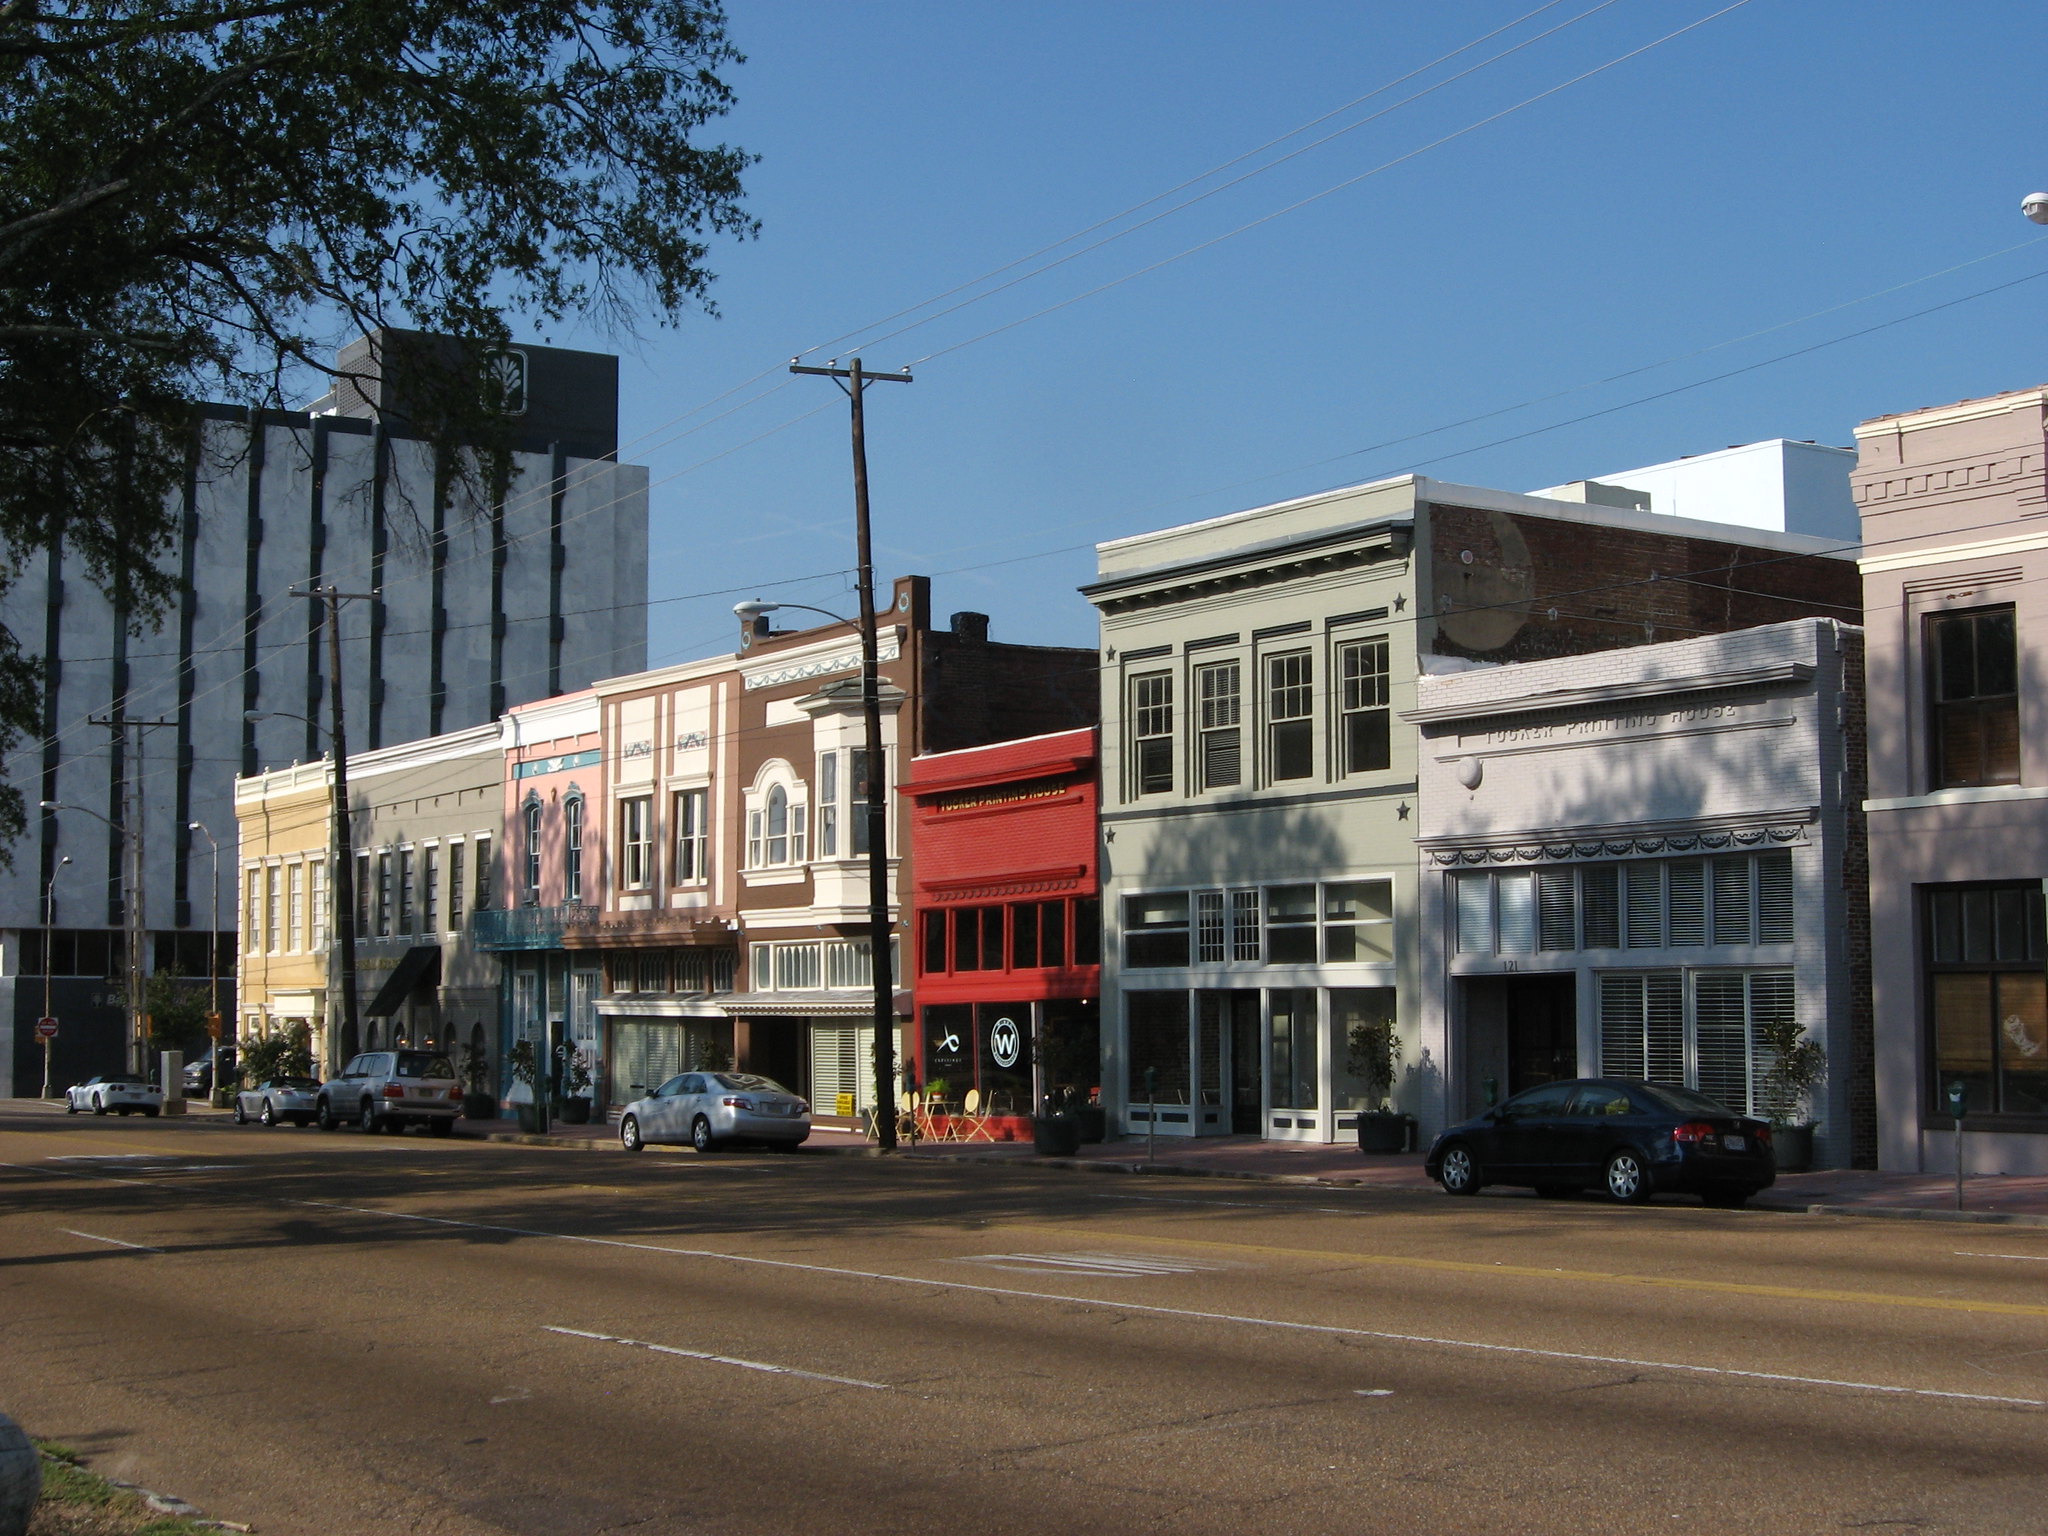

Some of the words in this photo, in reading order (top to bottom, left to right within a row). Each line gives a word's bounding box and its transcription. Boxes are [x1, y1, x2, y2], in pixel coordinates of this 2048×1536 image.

[1484, 724, 1553, 744] TUCKER
[1565, 711, 1656, 734] PRINTING
[1670, 704, 1735, 723] HOUSE
[941, 796, 977, 811] TUCKER
[978, 789, 1027, 806] PRINTING
[1029, 783, 1066, 799] HOUSE
[1504, 960, 1519, 972] 121
[995, 1033, 1015, 1054] W
